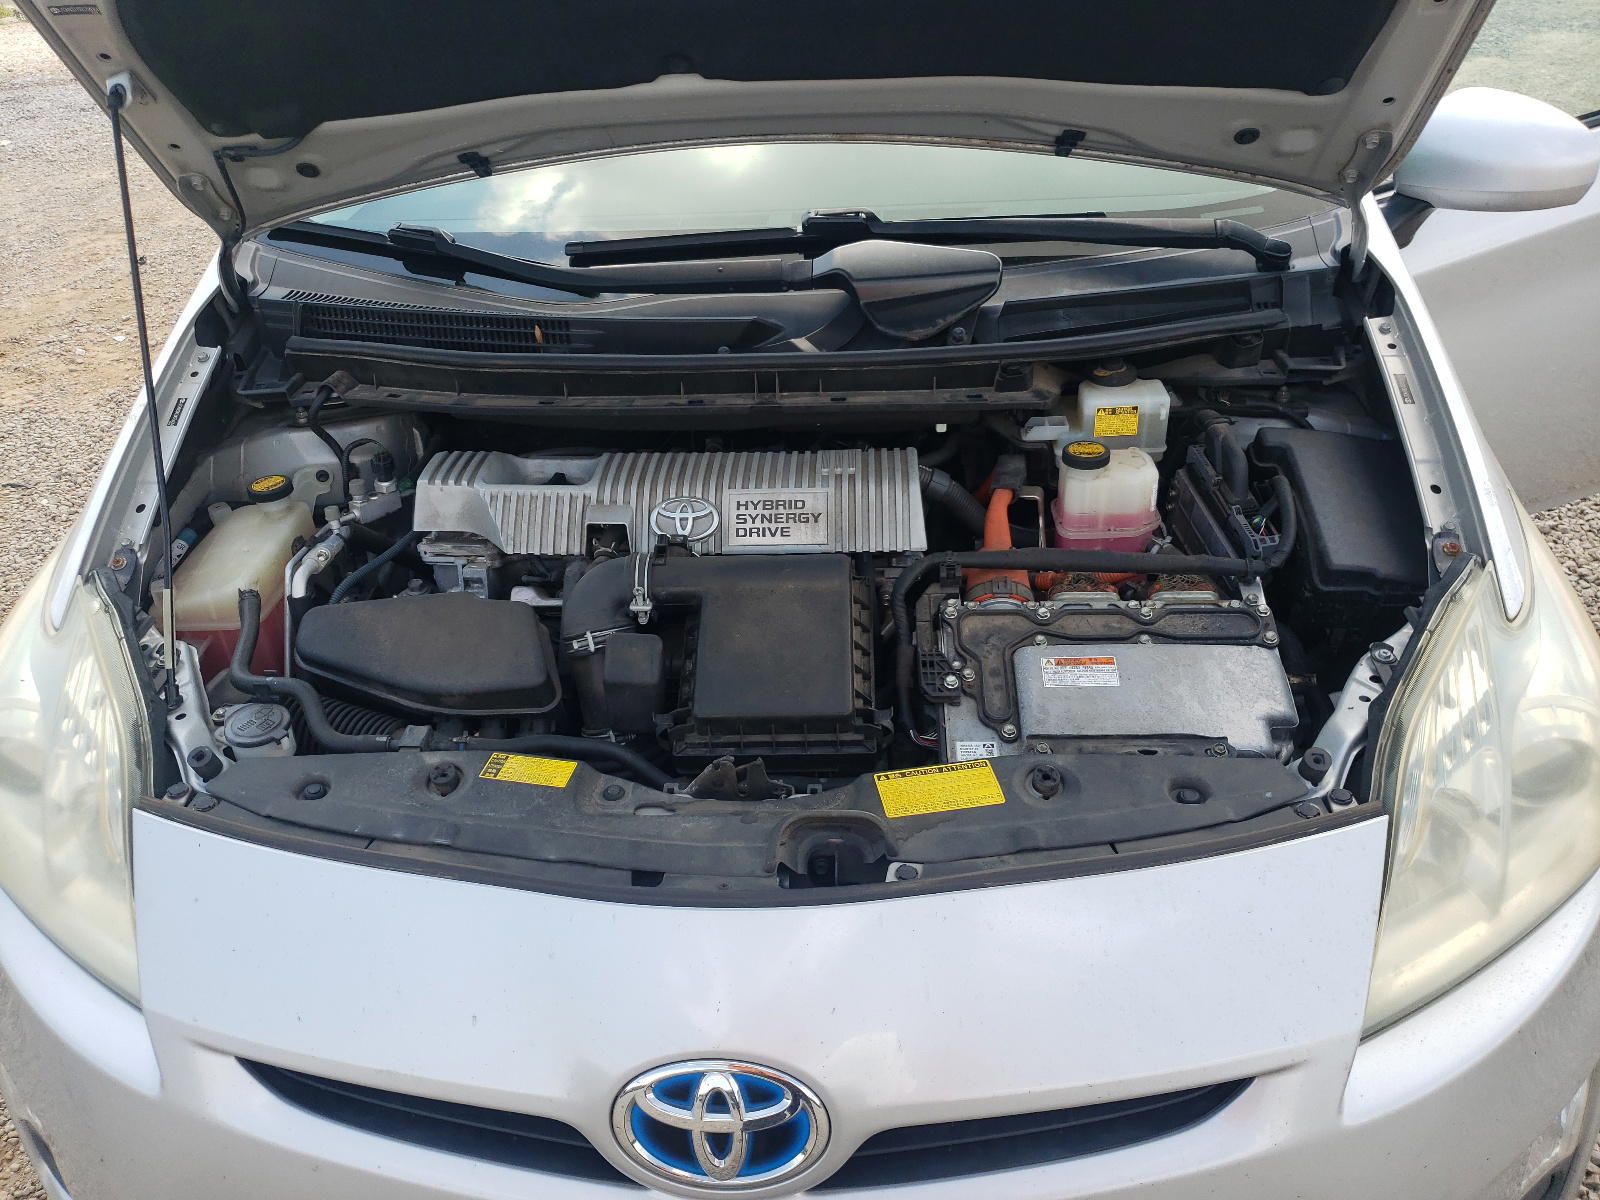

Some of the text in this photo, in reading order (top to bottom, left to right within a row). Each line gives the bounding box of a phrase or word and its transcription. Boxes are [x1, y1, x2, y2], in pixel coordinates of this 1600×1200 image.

[736, 499, 806, 511] HYBRID
[735, 512, 823, 525] SYNERGY
[735, 526, 791, 538] DRIVE
[905, 767, 940, 777] CAUTION
[942, 761, 987, 773] ATTENTION
